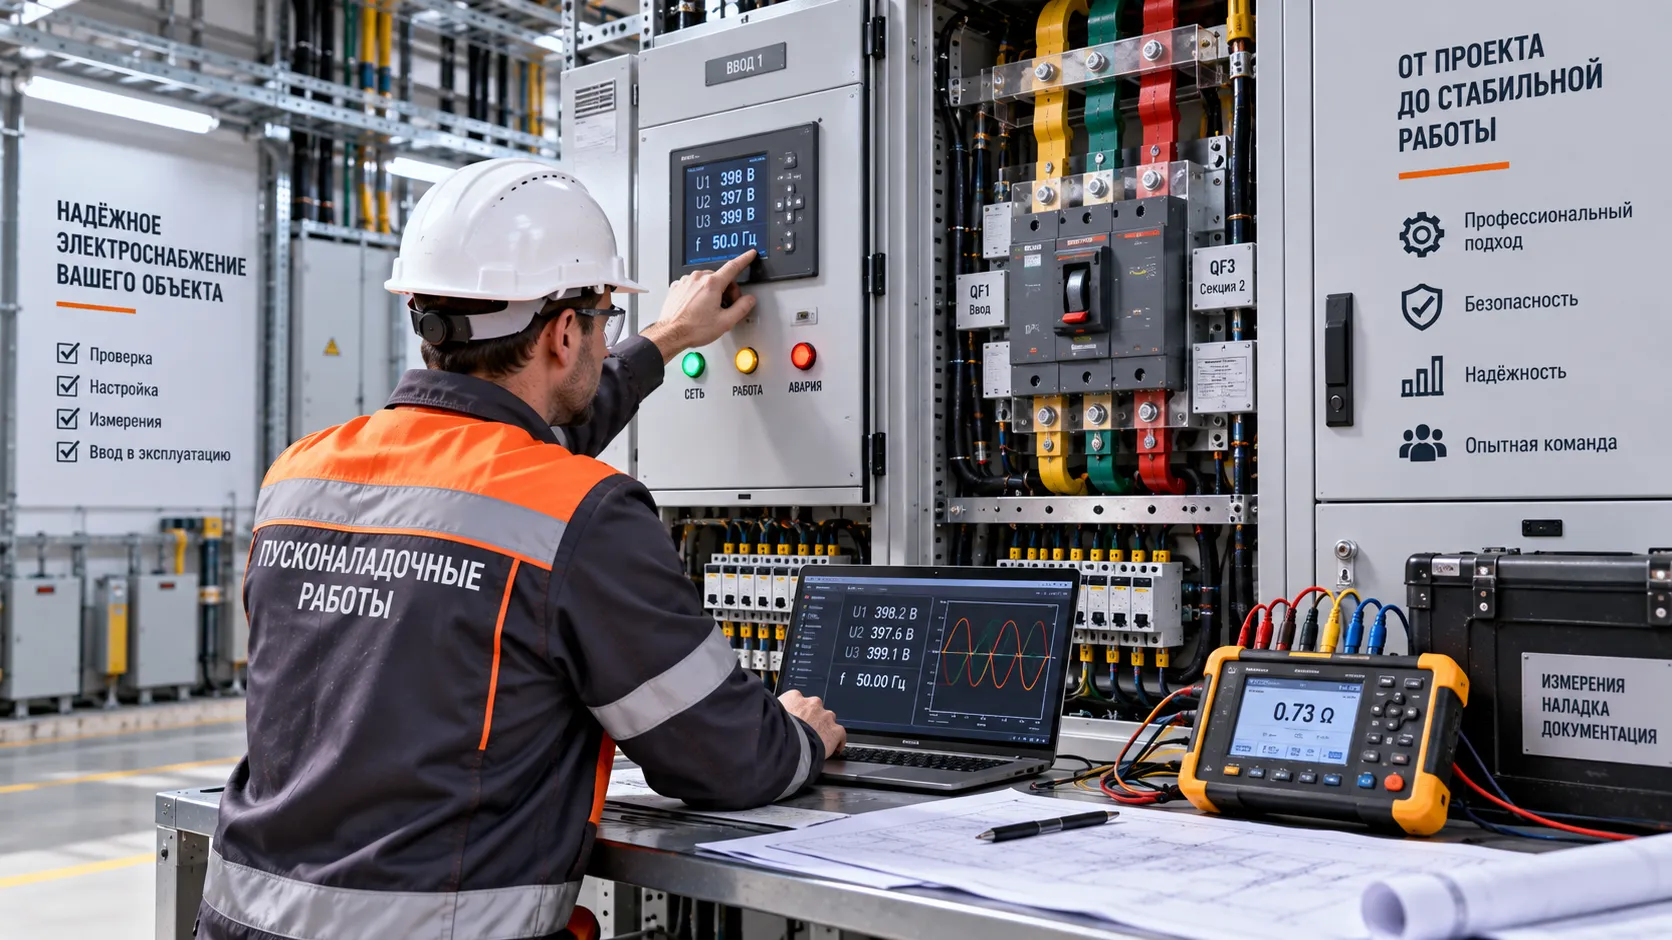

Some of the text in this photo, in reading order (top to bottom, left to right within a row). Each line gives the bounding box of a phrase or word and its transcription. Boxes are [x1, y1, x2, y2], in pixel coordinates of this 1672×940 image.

[726, 54, 762, 75] ВВОД 1
[1398, 32, 1545, 78] ОТ ПРОЕКТА
[1397, 57, 1603, 120] ДО СТАБИЛЬНОЙ
[1399, 116, 1496, 152] РАБОТЫ
[696, 167, 755, 190] U1 398 В
[696, 187, 755, 209] U2 397 В
[57, 200, 161, 235] НАДЁЖНОЕ
[696, 207, 755, 228] U3 399 В
[1464, 201, 1633, 231] Профессиональный
[695, 231, 757, 252] f 50.0 Гц
[1464, 235, 1523, 253] подход
[57, 231, 247, 276] ЭЛЕКТРОСНАБЖЕНИЕ
[1209, 258, 1236, 276] QF3
[57, 263, 223, 302] ВАШЕГО ОБЪЕКТА
[969, 283, 990, 300] QF1
[1199, 280, 1245, 296] Секция 2
[969, 304, 991, 316] Ввод
[1465, 293, 1579, 312] Безопасность
[90, 347, 153, 365] Проверка
[1465, 364, 1567, 384] Надёжность
[90, 379, 159, 397] Настройка
[684, 388, 705, 400] СЕТЬ
[732, 384, 763, 396] РАБОТА
[788, 380, 822, 393] АВАРИЯ
[90, 411, 162, 430] Измерения
[90, 445, 231, 463] Ввод в эксплуатацию
[1465, 435, 1618, 454] Опытная команда
[257, 539, 485, 591] ПУСКОНАЛАДОЧНЫЕ
[297, 582, 394, 619] РАБОТЫ
[852, 605, 918, 620] U1 398.2 В
[848, 626, 914, 641] U2 397.6 В
[844, 646, 911, 661] U3 399.1 В
[839, 671, 906, 691] f 50.00 Гц
[1541, 673, 1625, 693] ИЗМЕРЕНИЯ
[1273, 701, 1334, 724] 0.73 Ω
[1542, 697, 1610, 718] НАЛАДКА
[1541, 720, 1657, 745] ДОКУМЕНТАЦИЯ
